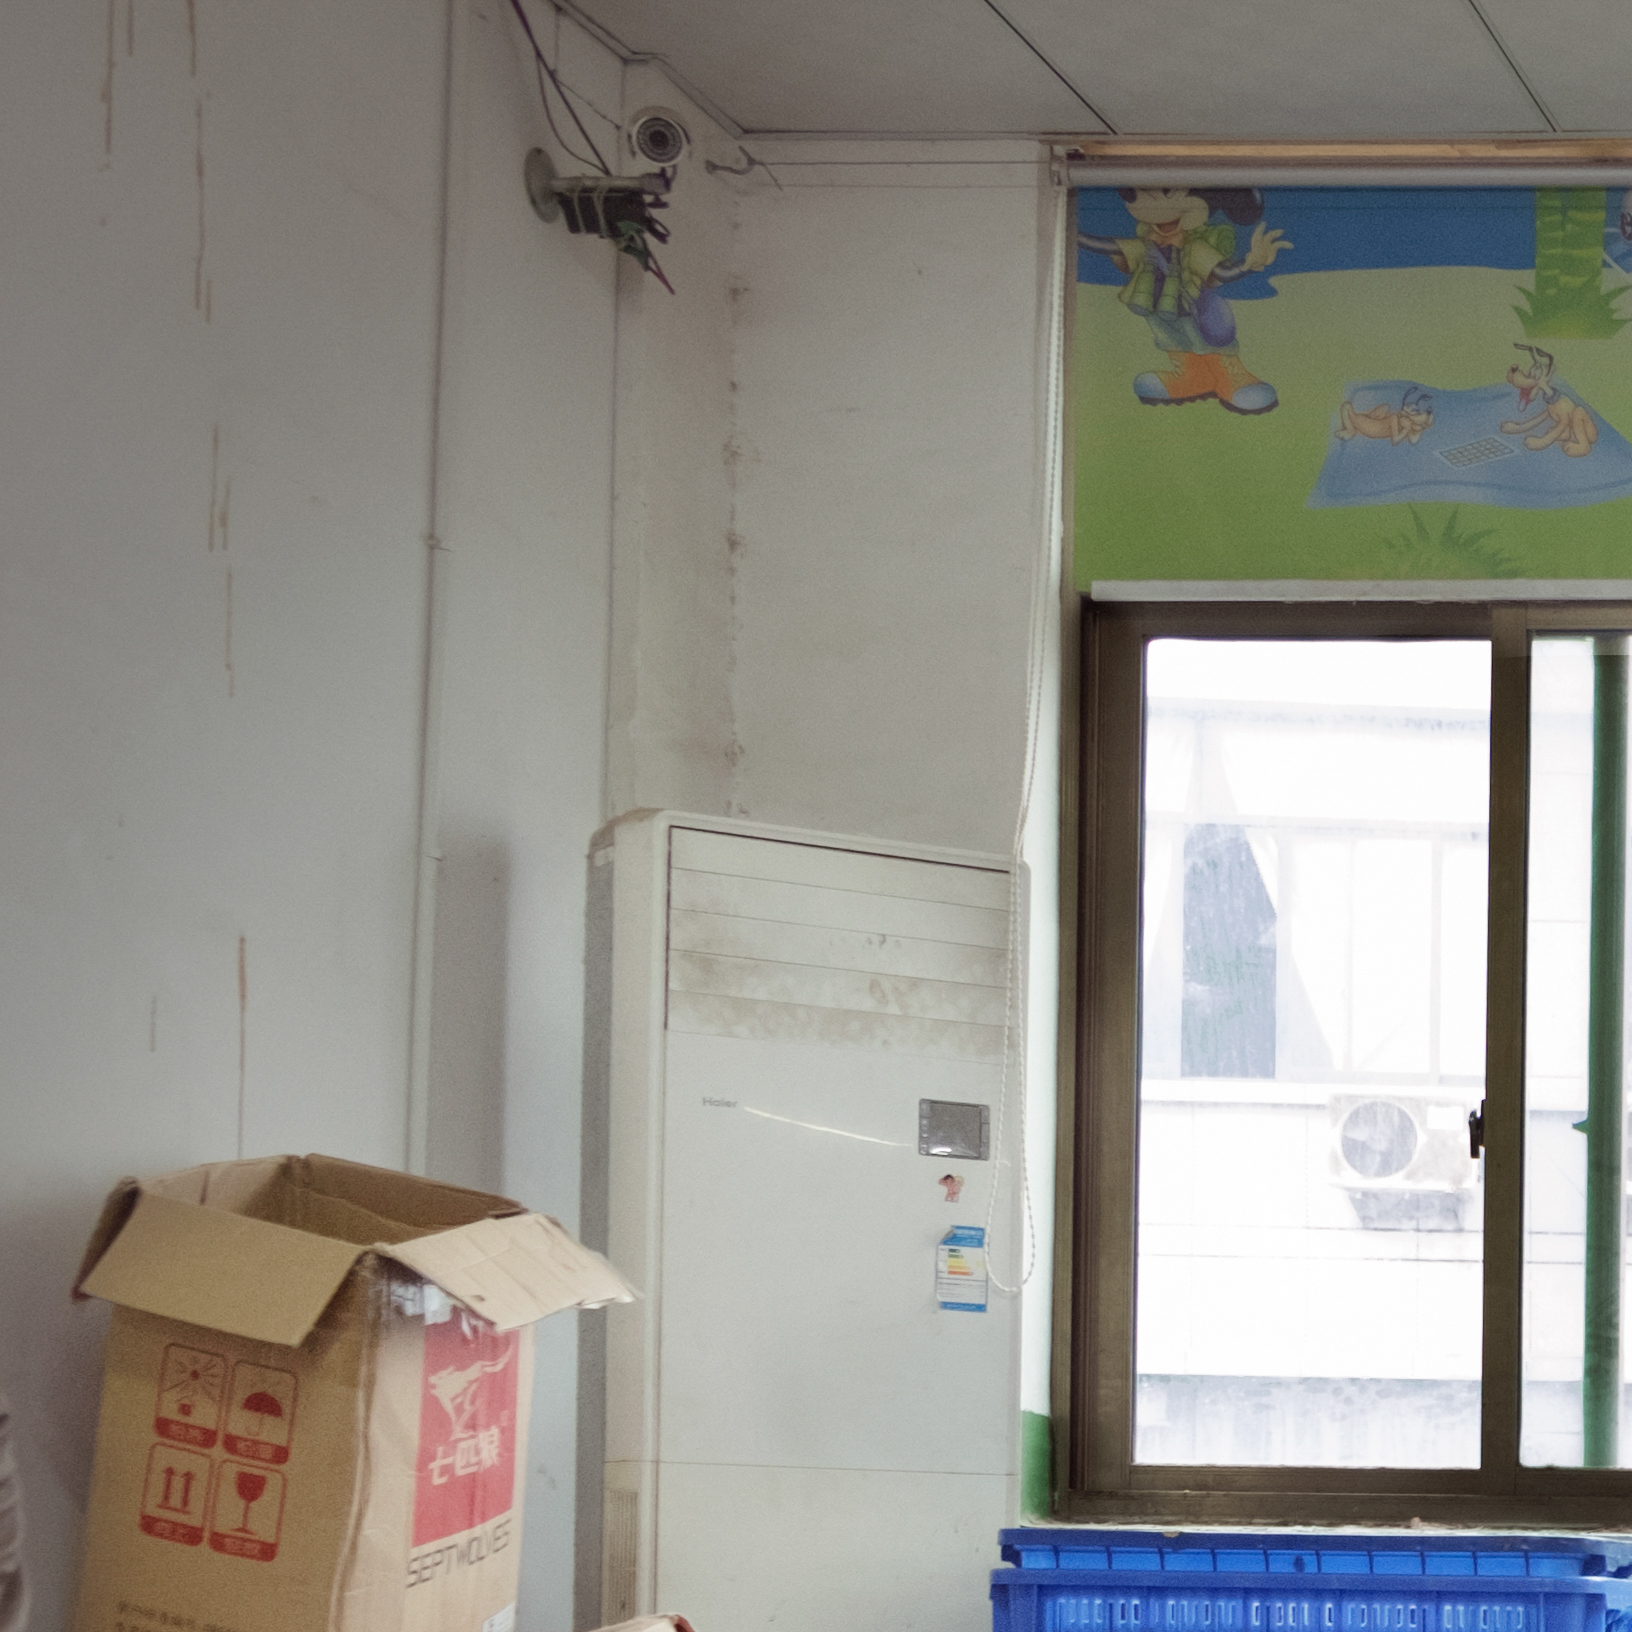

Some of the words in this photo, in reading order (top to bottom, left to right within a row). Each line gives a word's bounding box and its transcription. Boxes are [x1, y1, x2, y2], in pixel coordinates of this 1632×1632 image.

[701, 1096, 738, 1108] Haier
[428, 1426, 500, 1486] 七匹狼
[406, 1518, 513, 1589] SEPTWOLVES
